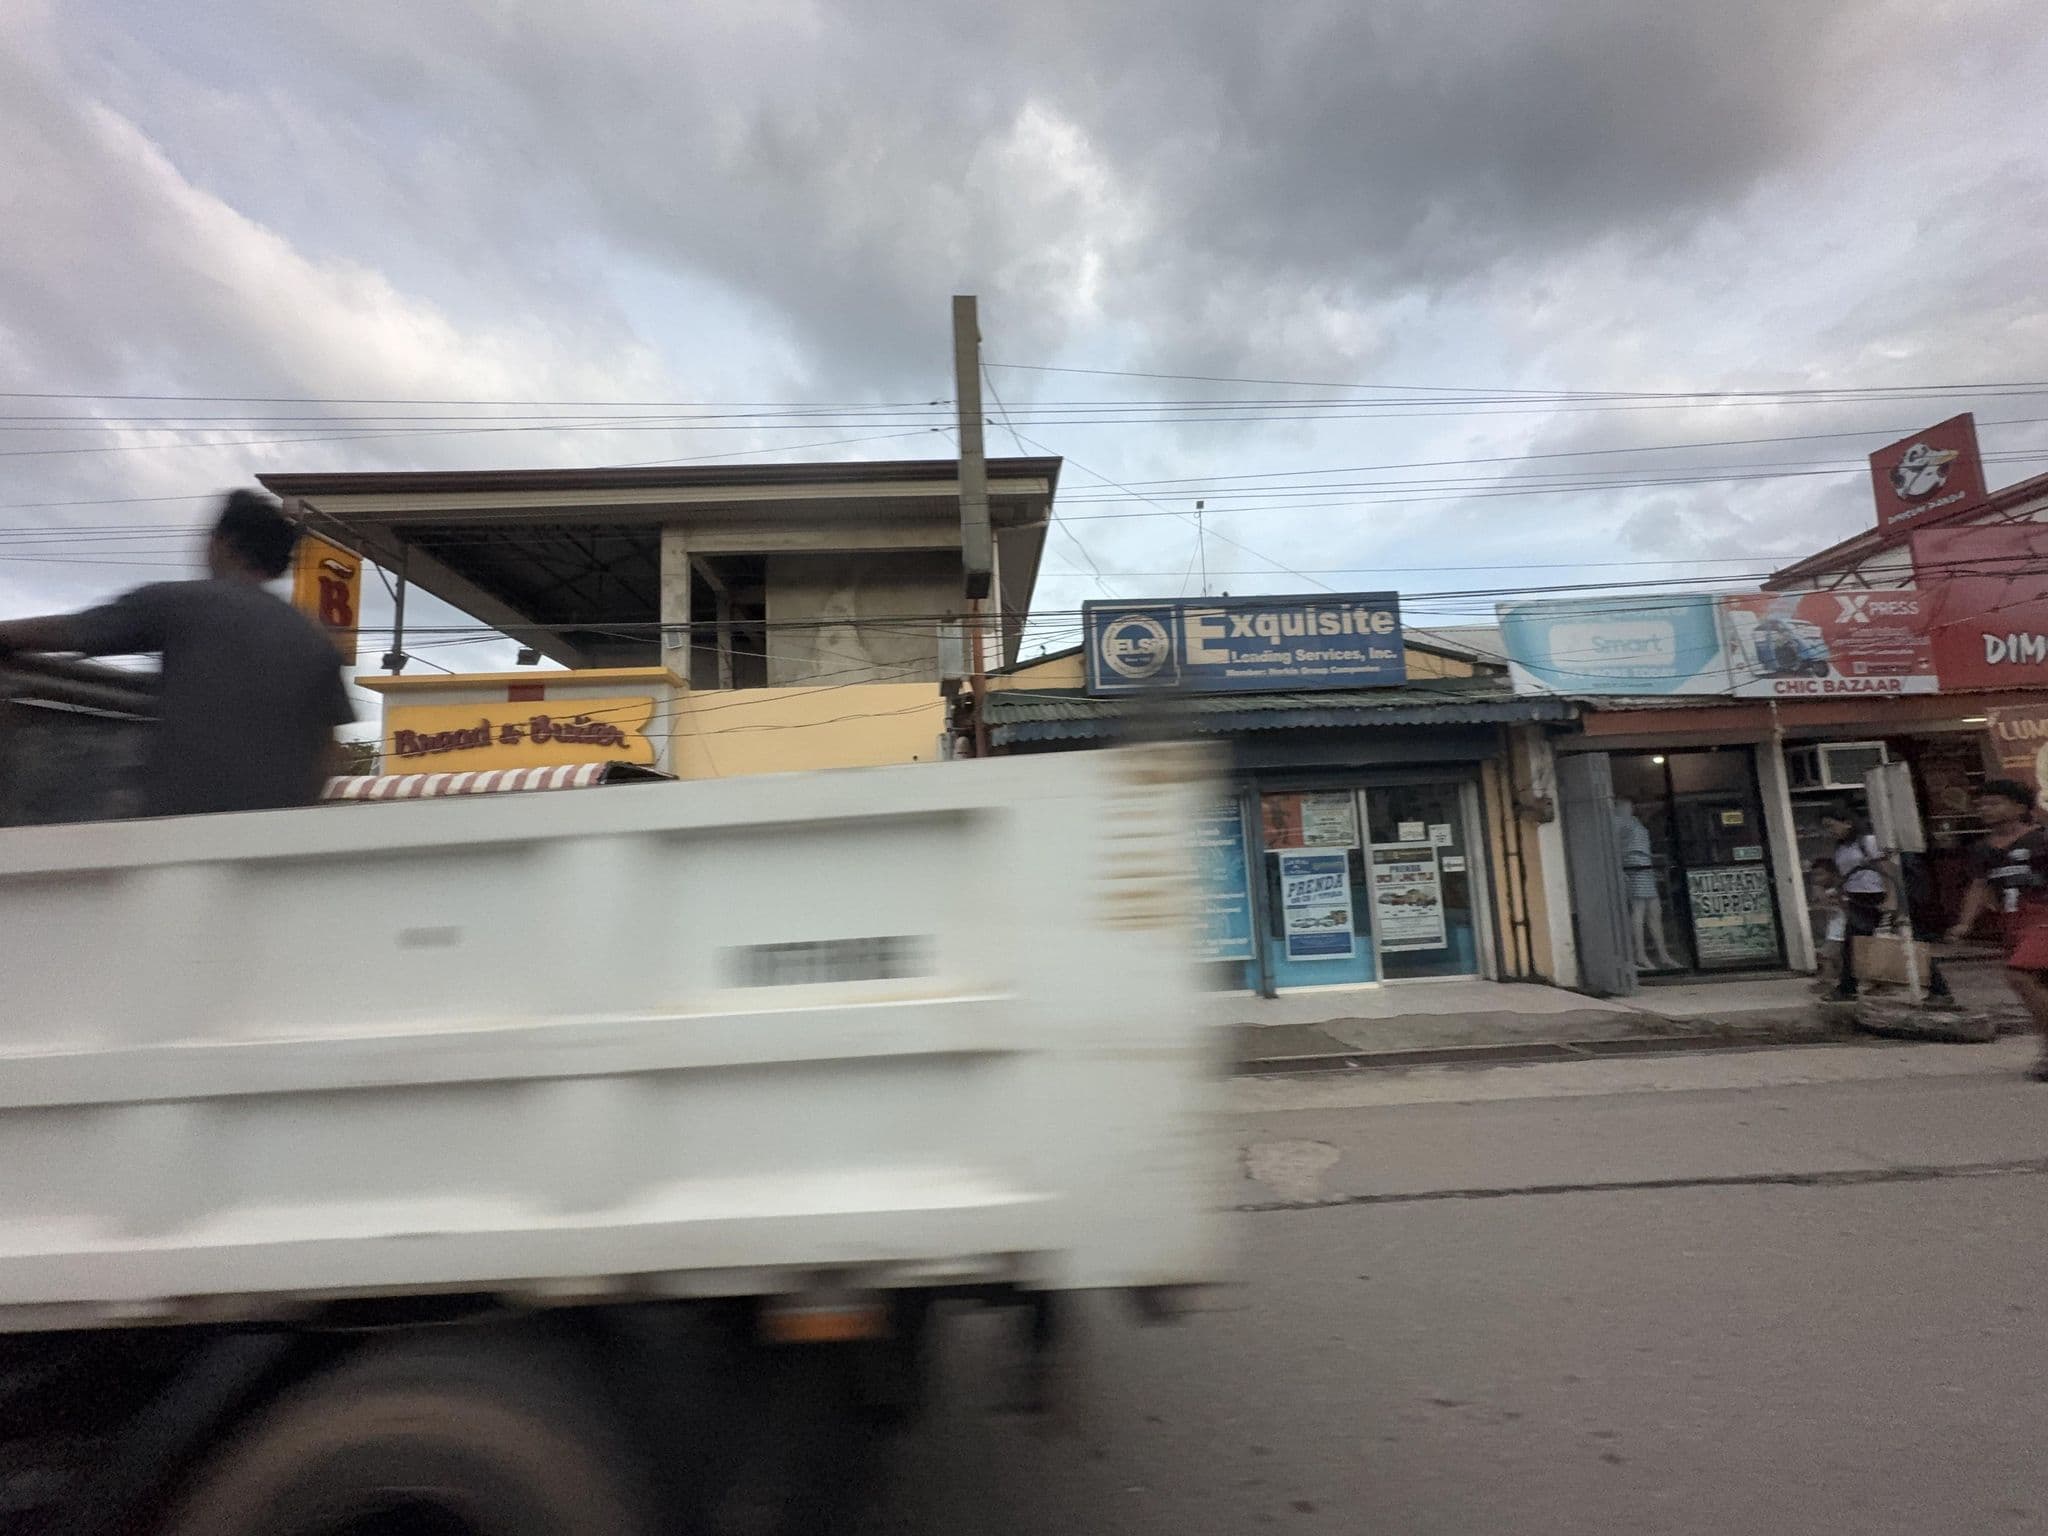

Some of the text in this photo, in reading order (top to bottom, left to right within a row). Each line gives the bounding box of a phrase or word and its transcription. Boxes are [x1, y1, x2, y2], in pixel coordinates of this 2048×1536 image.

[318, 575, 353, 627] B
[1183, 604, 1395, 665] Exquisite
[1591, 634, 1662, 656] Smart
[1982, 632, 2048, 665] DIM
[1775, 680, 1901, 694] CHIC BAZAAR
[1288, 874, 1344, 898] PRENDA
[1702, 894, 1761, 914] SUPPLY
